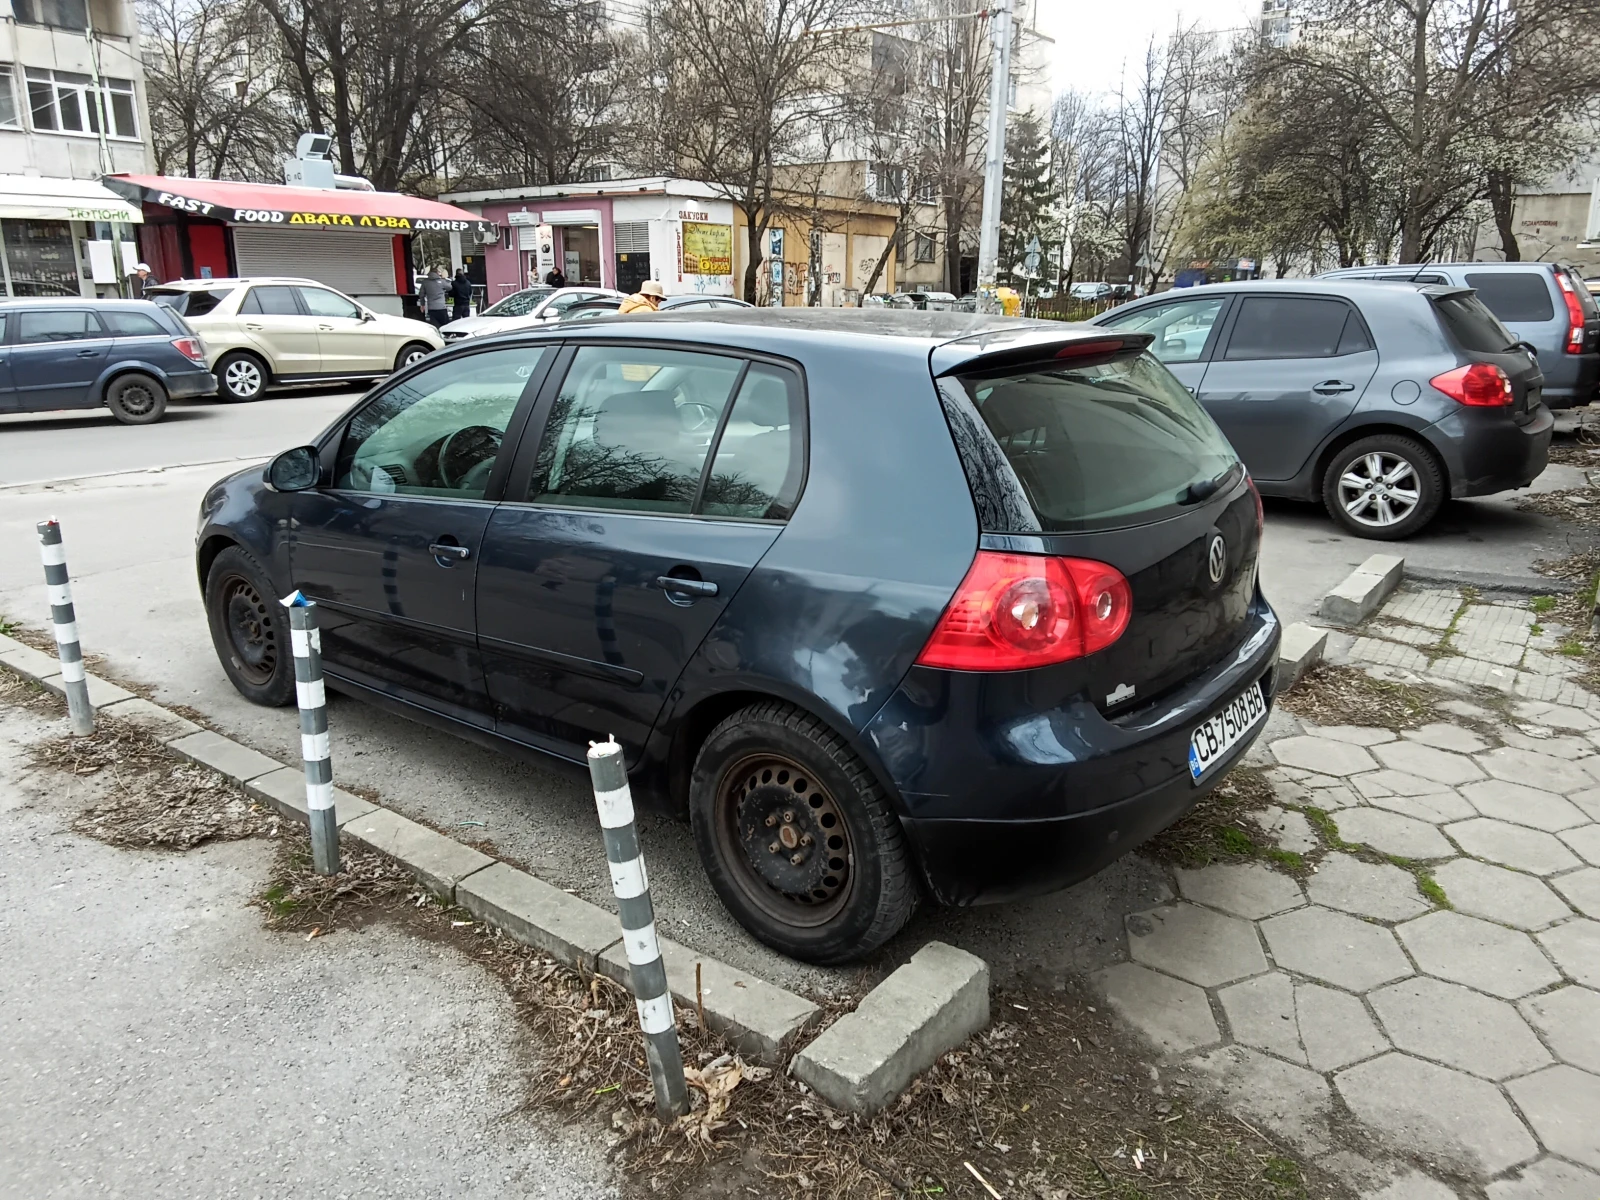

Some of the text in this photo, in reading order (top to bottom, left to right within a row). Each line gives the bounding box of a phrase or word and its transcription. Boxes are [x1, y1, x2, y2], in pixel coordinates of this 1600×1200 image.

[68, 207, 130, 221] ТЮТЮНИ
[158, 192, 486, 232] FAST FOOD ДВАТА ЛЪВА ДЮНЕР &
[678, 210, 709, 221] ЗАКУСКИ
